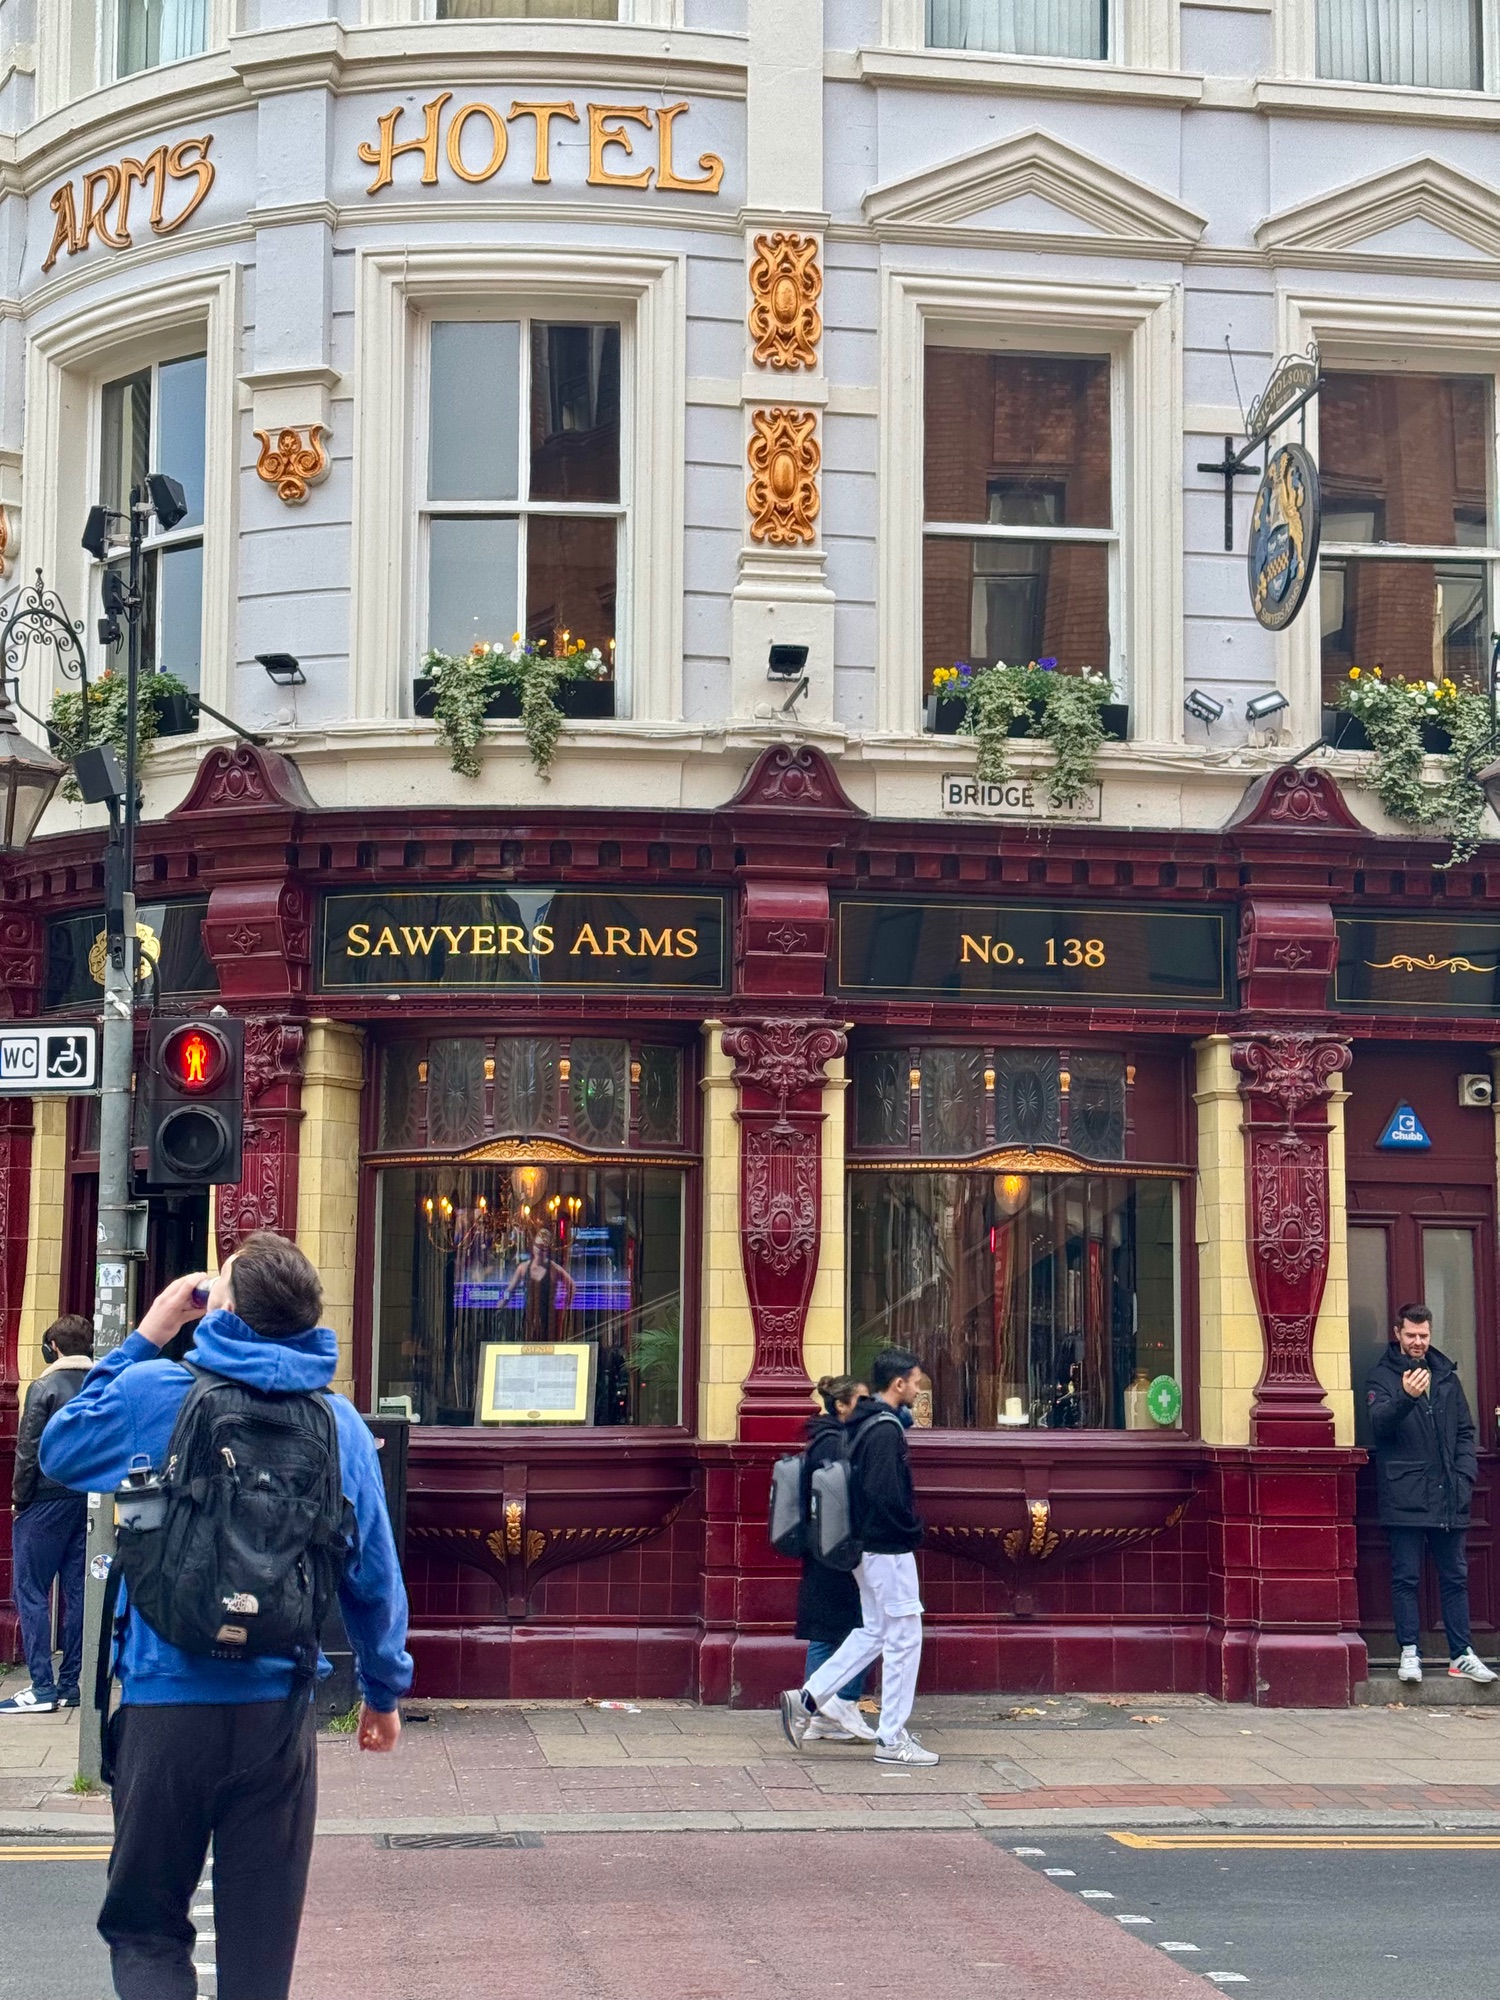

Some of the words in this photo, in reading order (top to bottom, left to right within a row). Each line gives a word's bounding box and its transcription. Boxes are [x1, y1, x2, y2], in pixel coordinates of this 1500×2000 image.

[357, 92, 725, 195] HOTEL
[41, 133, 215, 273] ARMS
[1256, 369, 1312, 434] NICHOLSON'S
[949, 784, 1035, 808] BRIDGE
[346, 923, 555, 957] SAWYERS
[569, 923, 698, 958] ARMS
[960, 934, 1024, 964] No.
[1045, 938, 1106, 967] 138
[4, 1047, 35, 1069] WC
[1392, 1131, 1423, 1141] Chubb
